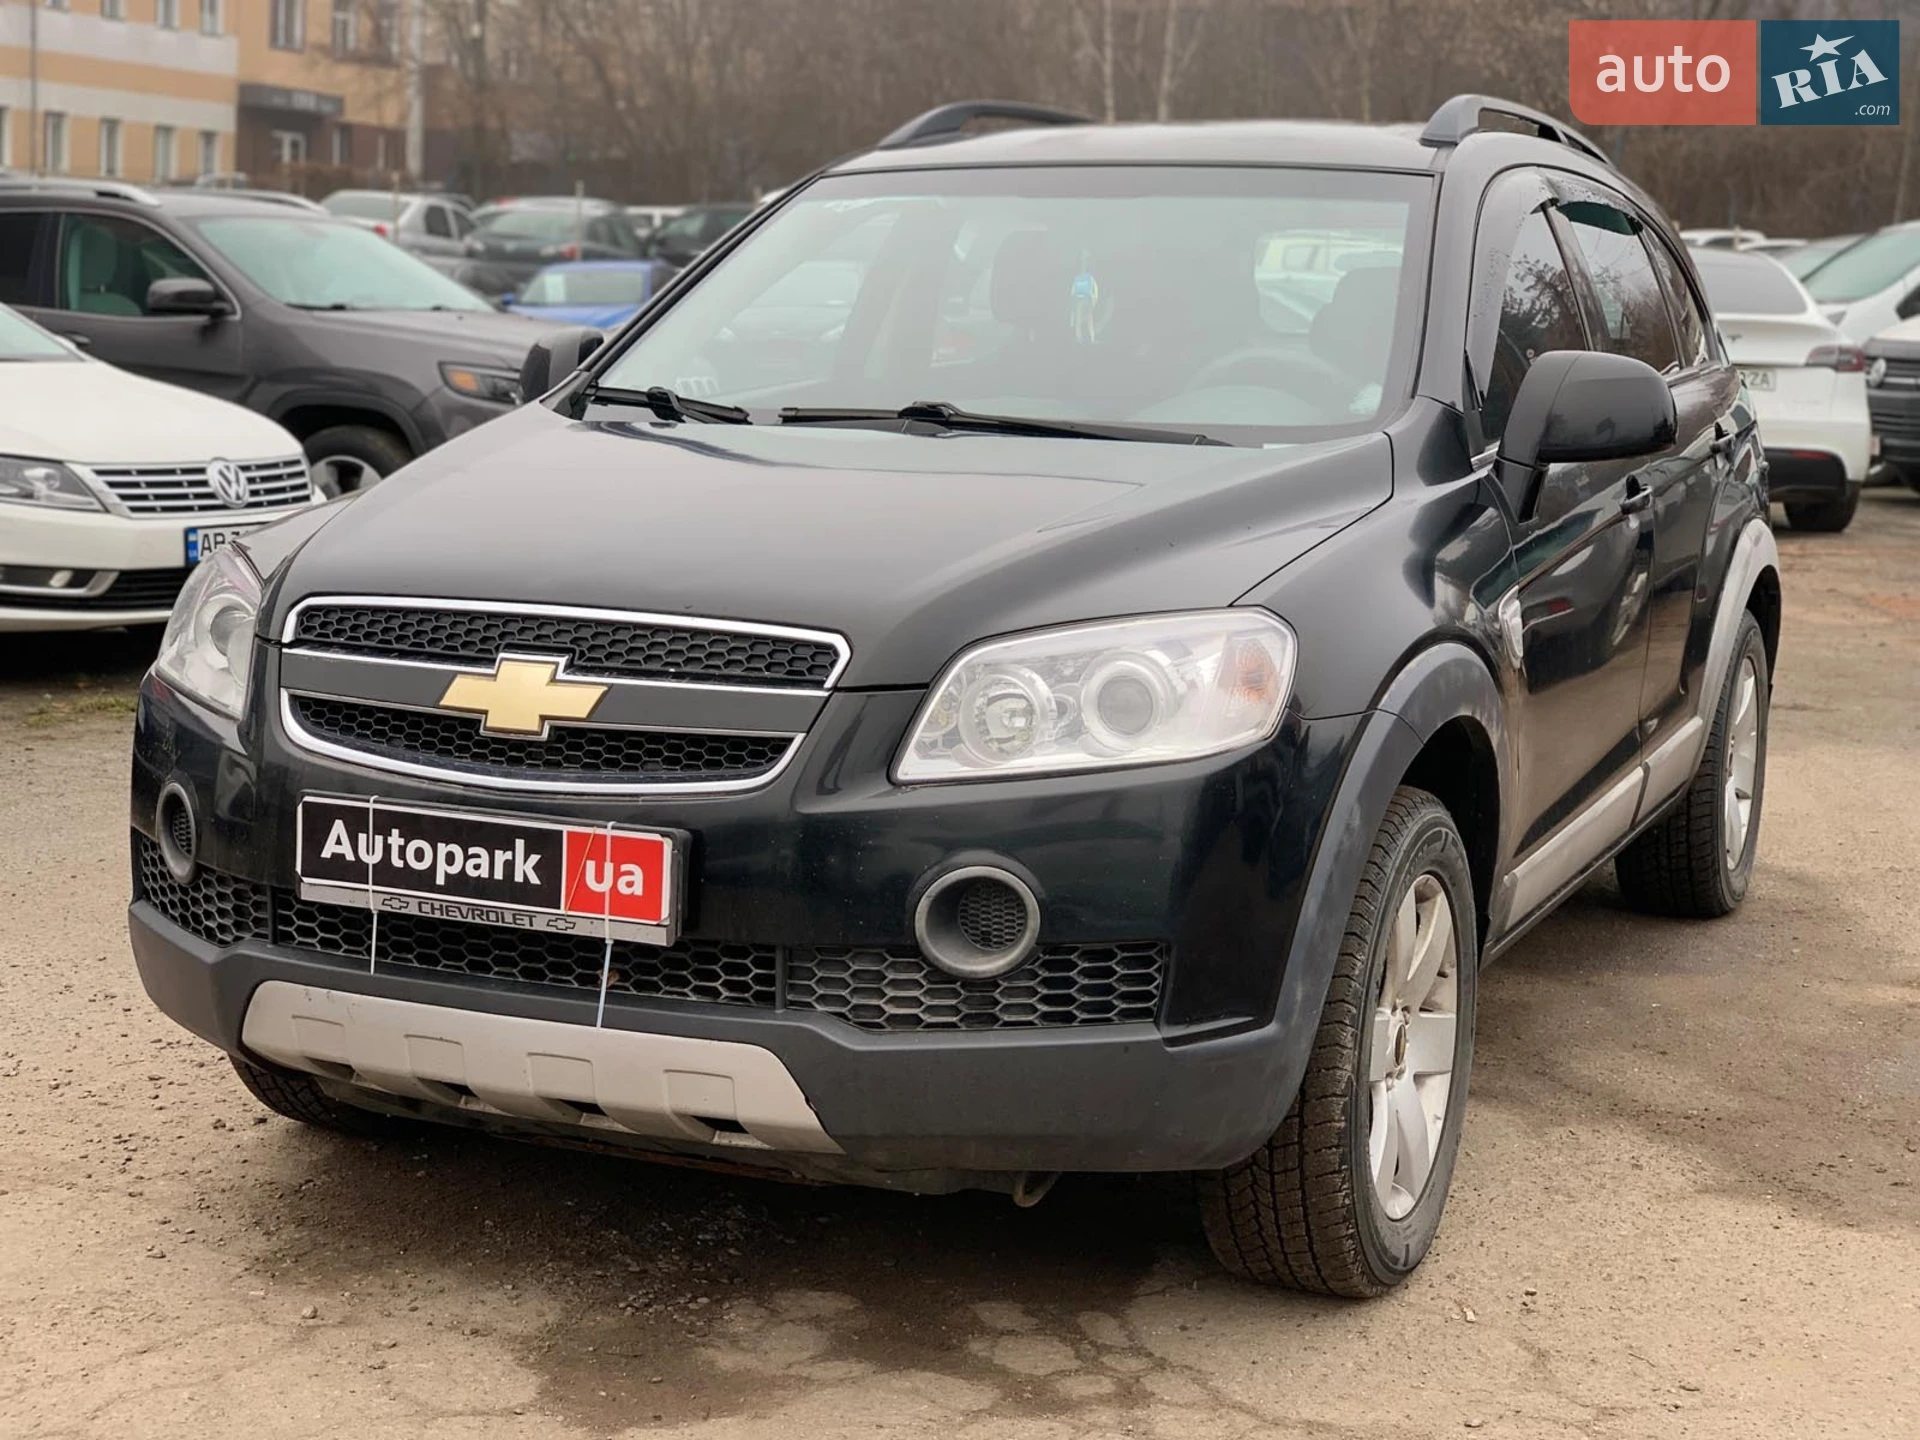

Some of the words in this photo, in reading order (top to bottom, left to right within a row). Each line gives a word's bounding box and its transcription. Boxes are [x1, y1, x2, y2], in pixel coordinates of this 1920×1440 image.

[320, 819, 542, 886] Autopark
[584, 859, 645, 897] ua
[417, 901, 537, 928] CHEVROLET
